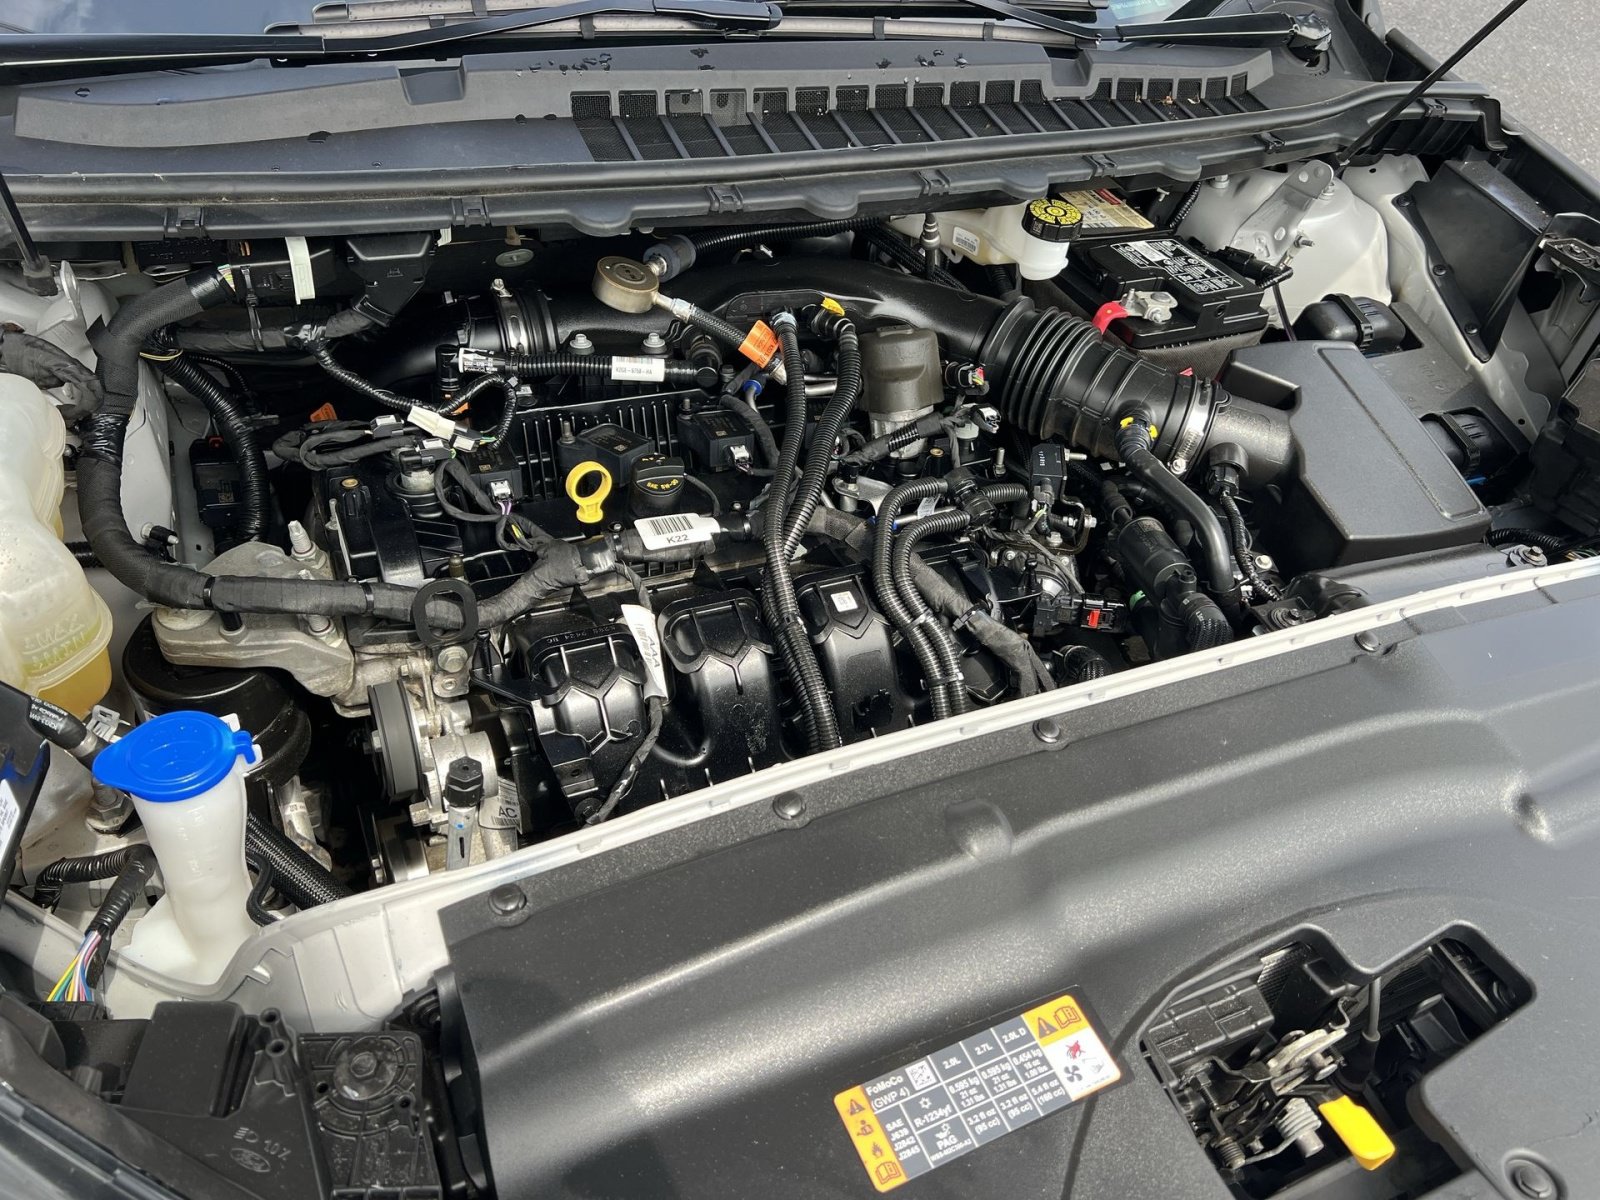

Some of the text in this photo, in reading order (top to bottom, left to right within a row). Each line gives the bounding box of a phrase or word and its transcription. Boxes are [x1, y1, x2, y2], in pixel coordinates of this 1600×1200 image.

[666, 534, 689, 544] K22
[499, 805, 517, 818] AC
[1002, 1027, 1027, 1044] 2.0L D
[974, 1043, 994, 1055] 2.7L
[1031, 1048, 1043, 1058] kg
[942, 1057, 962, 1070] 2.0L
[1000, 1061, 1013, 1071] kg
[865, 1075, 904, 1097] FoMoCo
[968, 1076, 981, 1086] kg
[1031, 1085, 1044, 1096] 5.4
[1049, 1079, 1060, 1088] oz
[871, 1086, 911, 1110] (GWP 4)
[1053, 1086, 1066, 1097] cc)
[1000, 1100, 1012, 1110] 3.2
[1018, 1093, 1029, 1102] oz
[913, 1104, 952, 1128] R-1234yf
[967, 1115, 979, 1126] 3.2
[986, 1108, 997, 1117] oz
[1007, 1101, 1033, 1120] (95 cc)
[885, 1118, 904, 1132] SAE
[975, 1116, 1001, 1135] (95 cc)
[891, 1128, 910, 1142] J639
[936, 1135, 958, 1150] PAG
[894, 1136, 916, 1152] J2842
[898, 1145, 921, 1160] J2845
